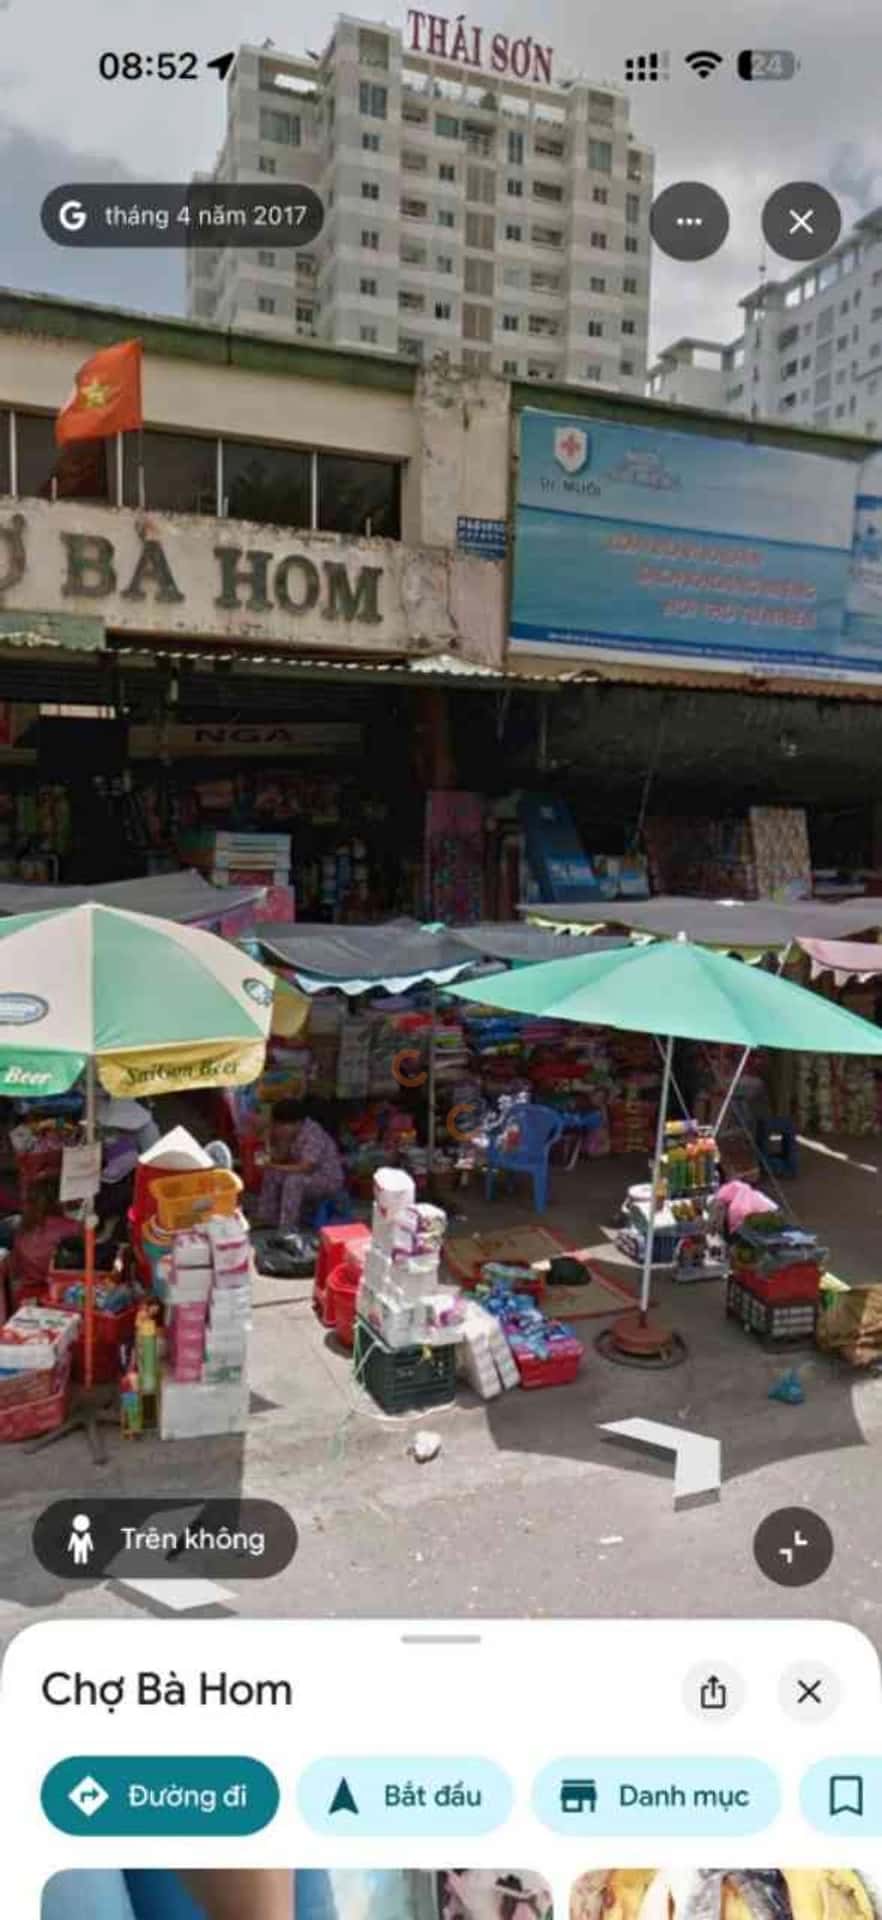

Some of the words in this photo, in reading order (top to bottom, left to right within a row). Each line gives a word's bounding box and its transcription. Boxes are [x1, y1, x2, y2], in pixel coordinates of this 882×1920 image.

[407, 9, 482, 66] THÁI
[491, 33, 555, 83] SƠN
[60, 518, 186, 604] BÀ
[214, 546, 385, 625] HOM
[194, 727, 294, 743] NGA
[4, 1065, 53, 1085] Beer
